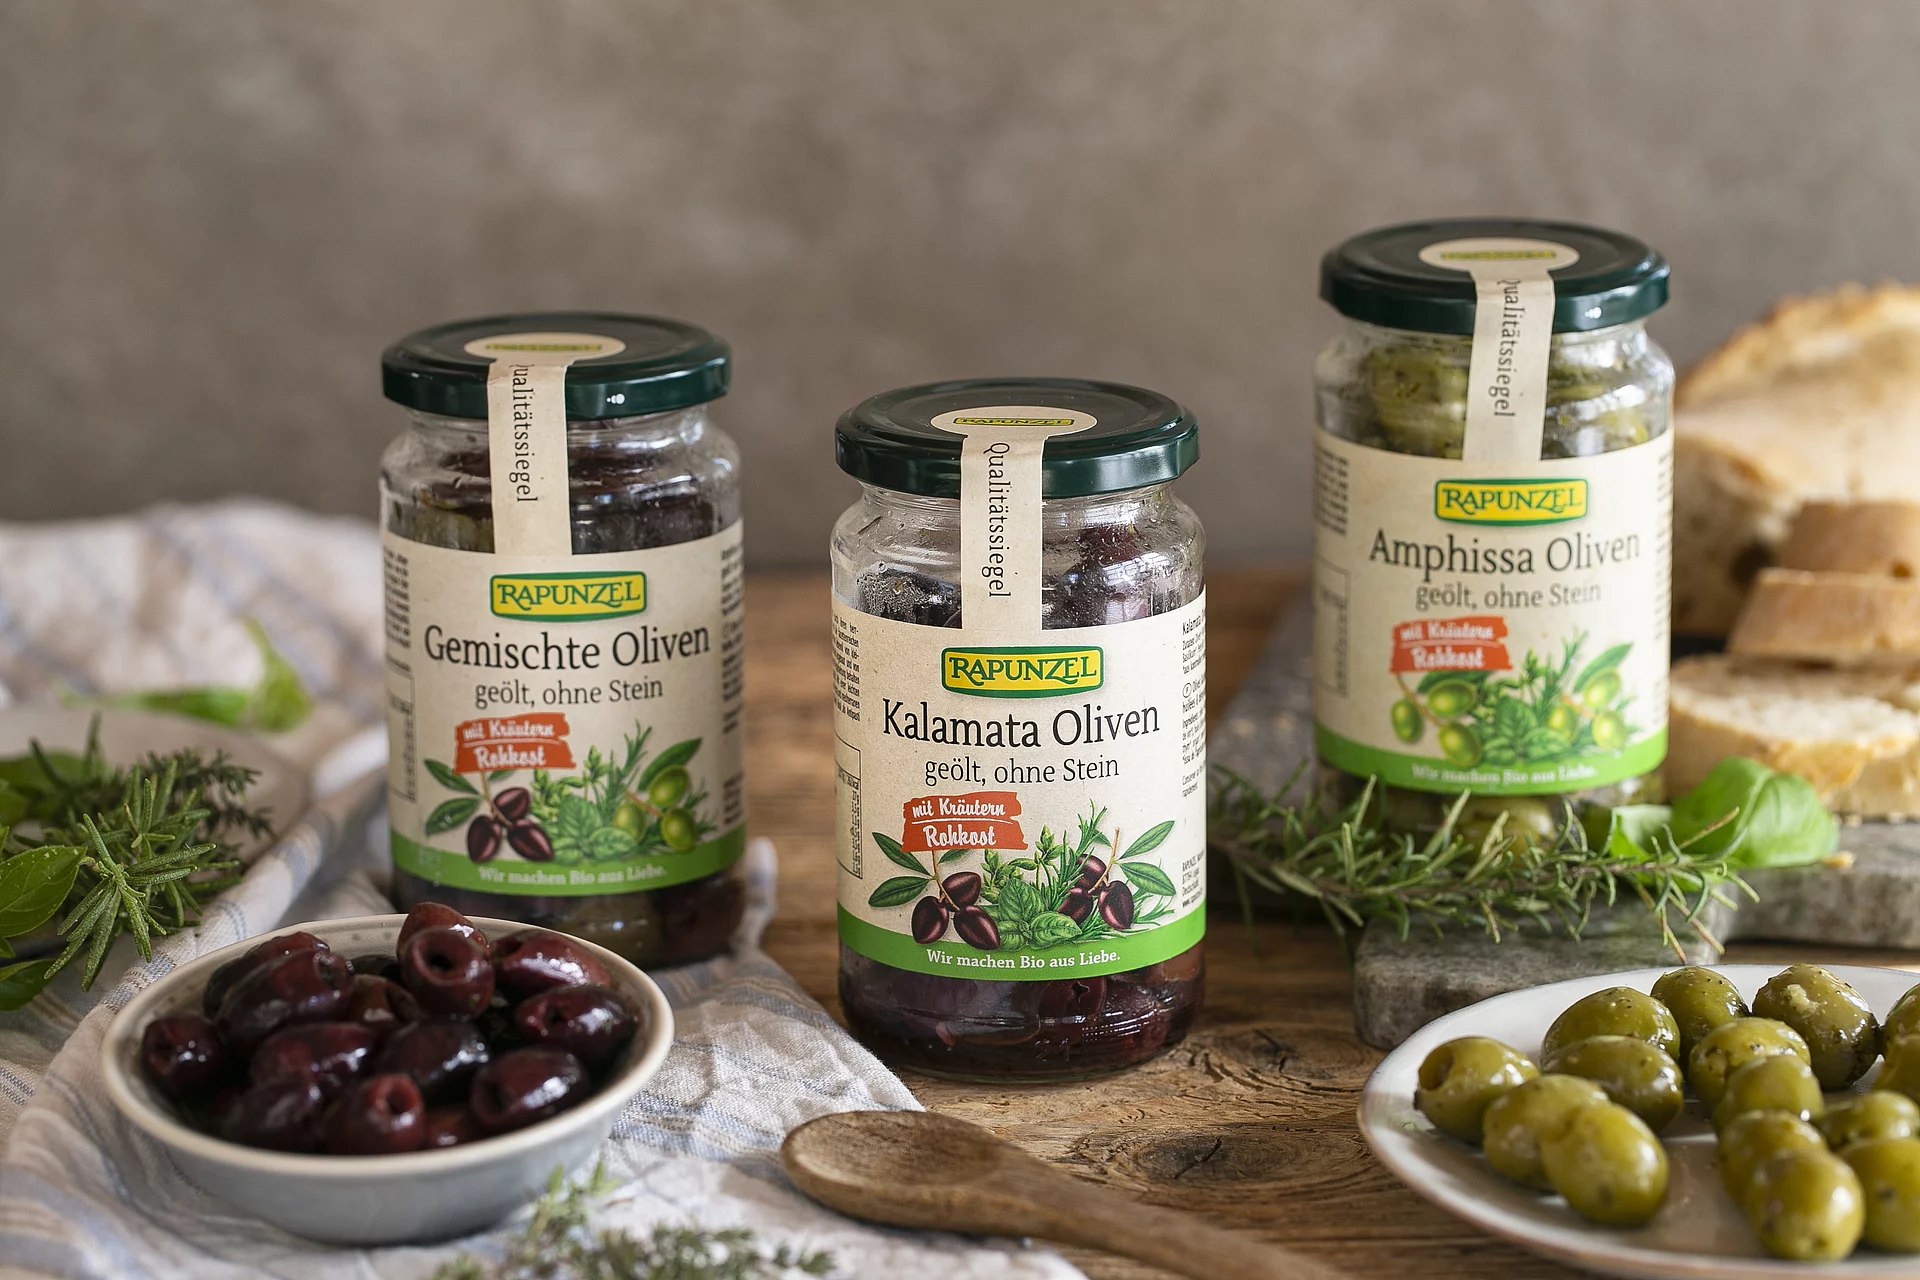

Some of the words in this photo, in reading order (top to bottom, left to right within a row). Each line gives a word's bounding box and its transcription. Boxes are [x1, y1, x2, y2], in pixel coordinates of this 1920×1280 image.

[1442, 487, 1583, 515] RAPUNZEL
[982, 442, 1011, 597] Qualitätssiegel
[1369, 527, 1536, 583] Amphissa
[1546, 532, 1641, 573] Oliven
[497, 581, 640, 611] RAPUNZEL
[1416, 581, 1478, 612] geölt,
[1484, 582, 1544, 609] ohne
[1550, 582, 1602, 606] Stein
[425, 625, 600, 670] Gemischte
[612, 624, 710, 667] Oliven
[949, 656, 1097, 686] RAPUNZEL
[475, 679, 535, 710] geölt,
[543, 680, 601, 705] ohne
[609, 676, 663, 702] Stein
[463, 722, 485, 740] mit
[488, 719, 555, 738] Kräutern
[883, 698, 1041, 748] Kalamata
[1052, 704, 1160, 746] Oliven
[473, 744, 547, 770] Rohkost
[925, 757, 987, 786] geölt,
[994, 758, 1056, 783] ohne
[1062, 754, 1120, 781] Stein
[912, 800, 934, 818] mit
[938, 797, 1006, 816] Kräutern
[922, 823, 997, 848] Rohkost
[478, 866, 505, 882] Wir
[508, 870, 566, 885] machen
[569, 870, 595, 885] Bio
[598, 870, 624, 883] aus
[927, 949, 952, 964] Wir
[957, 954, 1015, 969] machen
[1020, 955, 1045, 969] Bio
[1050, 956, 1075, 968] aus
[1080, 949, 1121, 967] Liebe.
